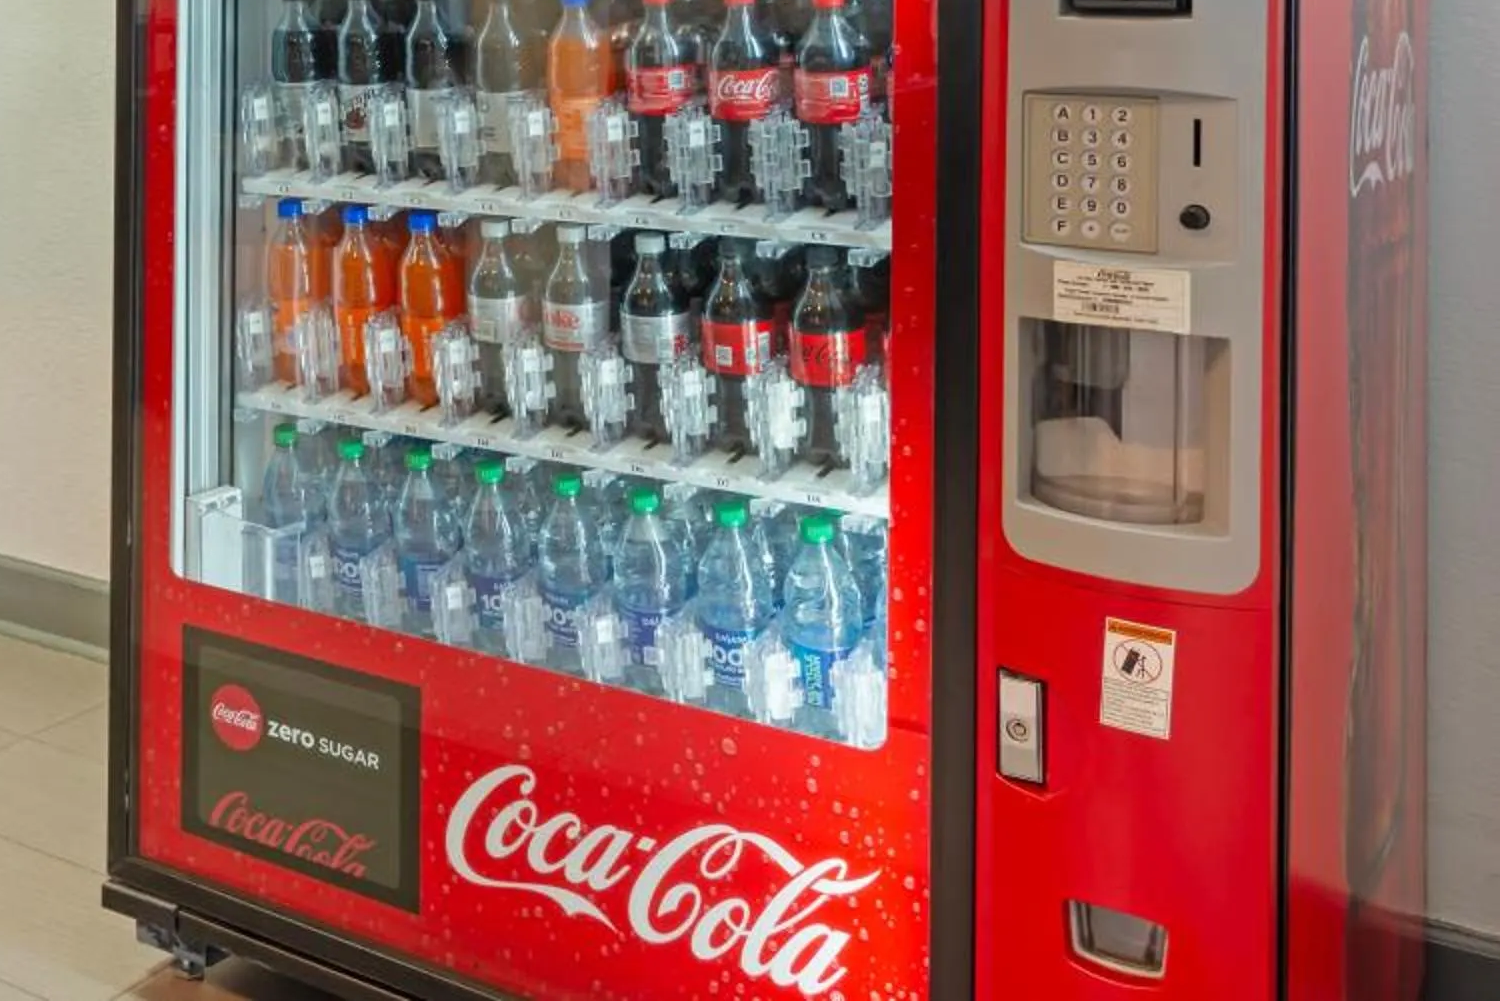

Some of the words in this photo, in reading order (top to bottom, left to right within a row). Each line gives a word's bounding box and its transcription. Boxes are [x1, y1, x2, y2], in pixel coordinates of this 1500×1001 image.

[1057, 107, 1069, 120] A
[1089, 109, 1096, 121] 1
[1117, 110, 1128, 122] 2
[1057, 130, 1069, 142] B
[1088, 131, 1097, 144] 3
[1117, 133, 1127, 145] 4
[1057, 152, 1069, 164] C
[1088, 154, 1097, 166] 5
[1117, 155, 1127, 168] 6
[1057, 174, 1069, 187] D
[1088, 176, 1097, 189] 7
[1057, 197, 1068, 210] E
[1087, 199, 1097, 212] 9
[1117, 202, 1127, 214] 0
[1057, 220, 1067, 232] F
[211, 702, 261, 731] Coca-Cola
[267, 719, 315, 749] zero
[318, 737, 381, 771] SUGAR
[444, 764, 883, 996] Coca-Cola
